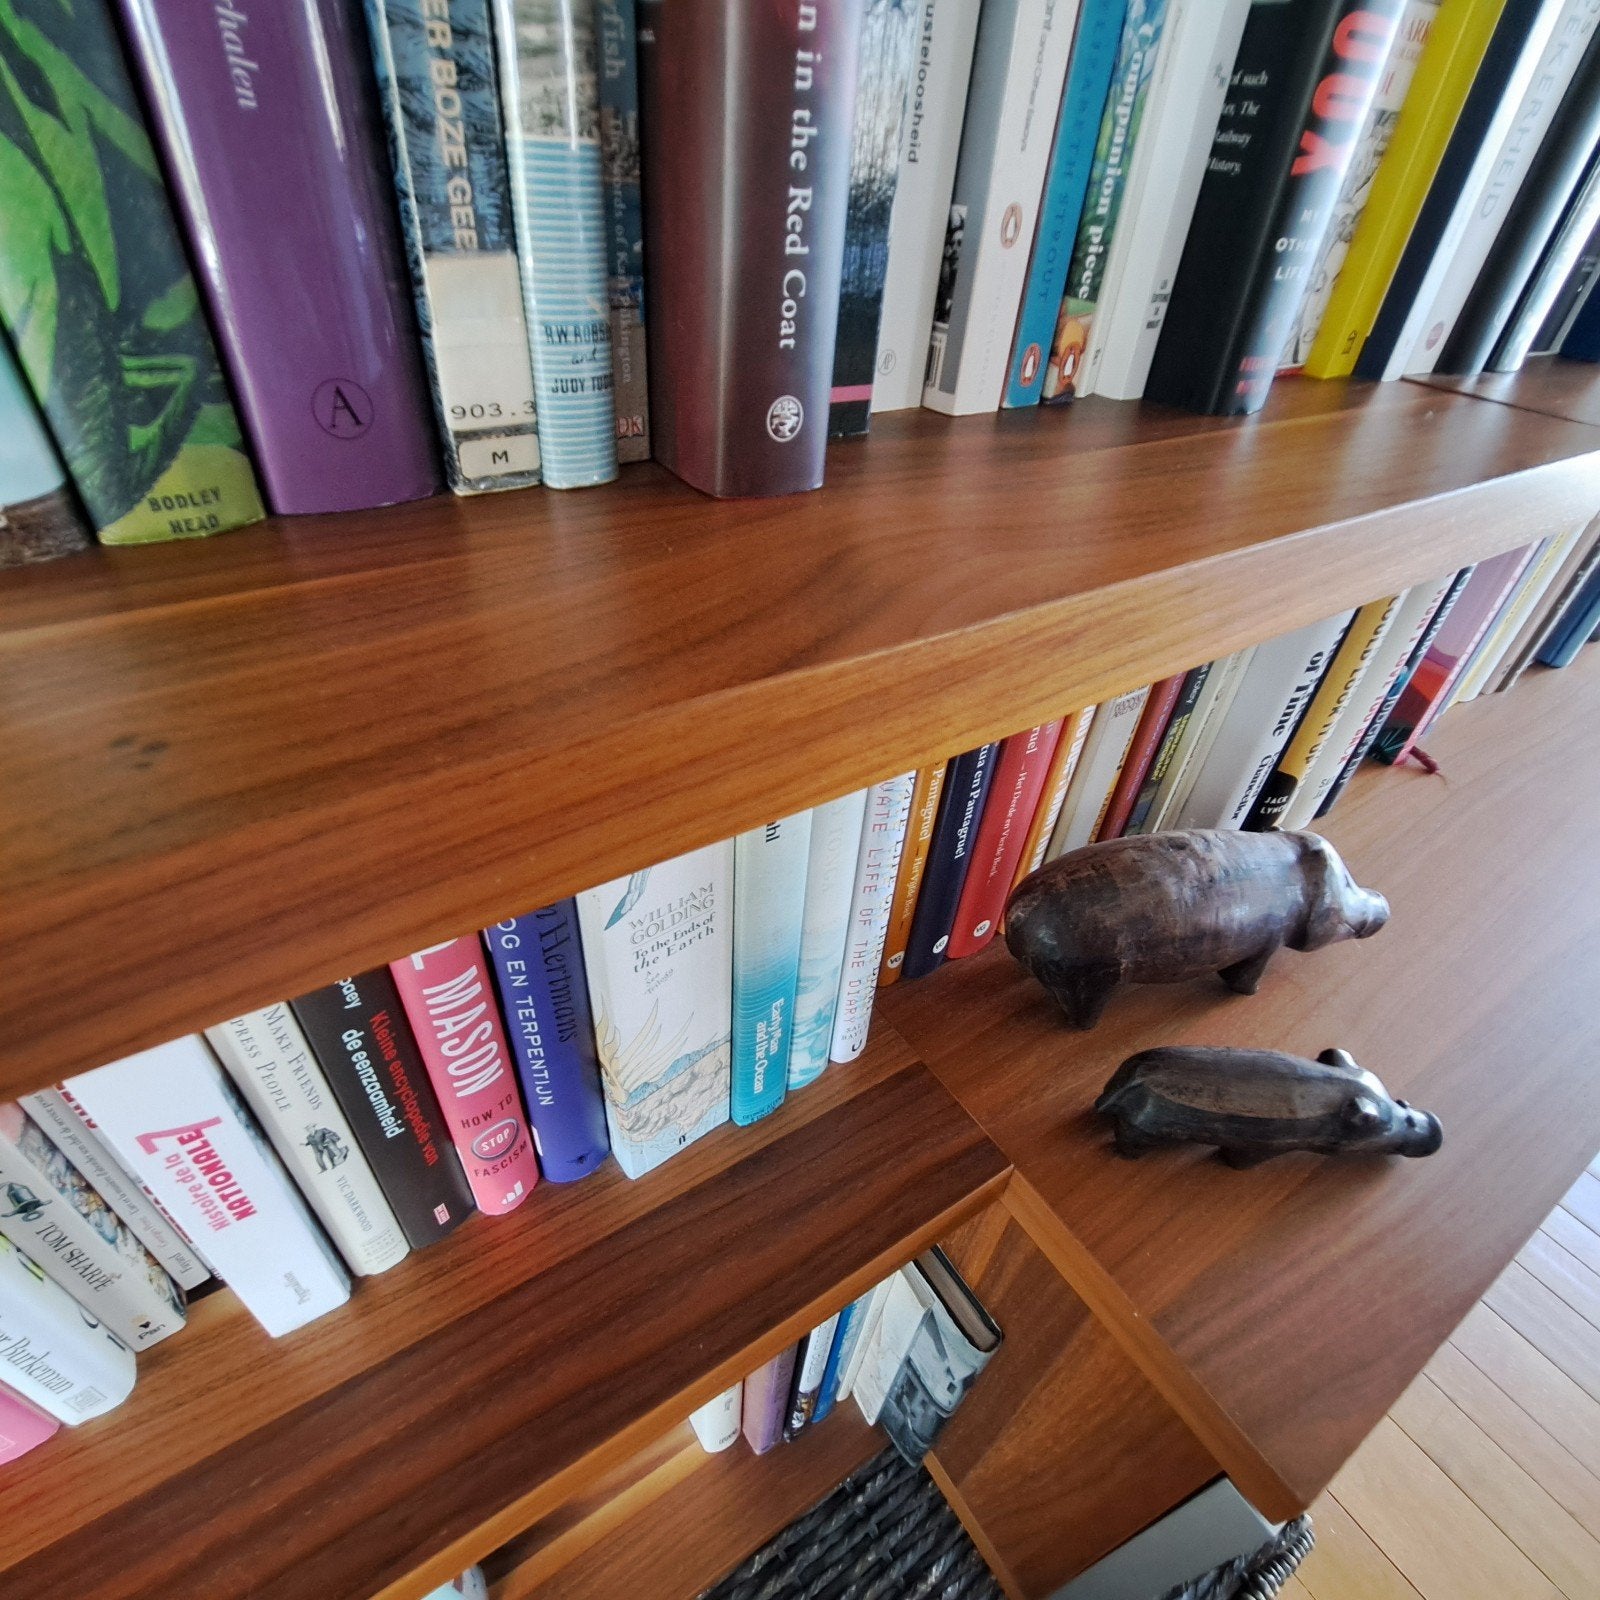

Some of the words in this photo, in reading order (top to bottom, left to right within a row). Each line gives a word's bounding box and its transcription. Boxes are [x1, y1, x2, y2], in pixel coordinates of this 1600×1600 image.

[602, 0, 626, 79] fish
[795, 50, 823, 91] in
[1242, 69, 1269, 86] such
[430, 58, 468, 167] BOZE
[789, 108, 819, 171] the
[785, 187, 813, 256] Red
[779, 269, 807, 350] Coat
[617, 417, 642, 436] DK
[491, 450, 510, 465] M
[147, 485, 220, 513] BODLEY
[168, 513, 219, 535] HEAD
[1303, 648, 1326, 677] of
[1268, 678, 1311, 740] Time
[973, 769, 984, 783] en
[1228, 752, 1274, 822] Chancellor
[1263, 795, 1289, 805] JACK
[918, 768, 946, 842] Pantagruel
[954, 784, 982, 860] Pantagruel
[1002, 818, 1011, 829] en
[1004, 789, 1023, 818] Derde
[992, 828, 1011, 857] Vierde
[862, 847, 883, 895] LIFE
[987, 856, 1001, 878] Boek
[628, 882, 715, 931] WILLIAM
[630, 894, 716, 945] GOLDING
[859, 907, 874, 927] OF
[632, 948, 649, 961] To
[650, 936, 671, 954] the
[673, 922, 701, 942] Ends
[702, 911, 717, 925] of
[633, 955, 660, 974] the
[666, 926, 716, 957] Earth
[850, 939, 869, 970] THE
[506, 959, 530, 988] EN
[538, 914, 578, 1045] Hertmans
[842, 979, 862, 1024] DIARY
[340, 1027, 366, 1051] de
[421, 963, 506, 1099] MASON
[515, 995, 555, 1107] TERPENTIJN
[256, 1059, 293, 1113] PEOPLE
[286, 1051, 323, 1112] FRIENDS
[350, 1044, 407, 1141] eenzaamheid
[368, 1008, 398, 1063] Kleine
[388, 1056, 434, 1146] encyclopedie
[422, 1139, 440, 1167] van
[753, 1059, 769, 1095] Ocean
[459, 1106, 495, 1130] HOW
[497, 1092, 515, 1112] TO
[164, 1152, 182, 1170] la
[473, 1140, 530, 1179] FASCISM
[479, 1126, 512, 1153] STOP
[175, 1165, 197, 1185] de
[177, 1128, 258, 1222] NATIONALE
[188, 1180, 231, 1232] Histoire
[335, 1174, 350, 1194] VIC
[344, 1190, 374, 1233] DARKWOOD
[35, 1222, 70, 1254] TOM
[61, 1248, 115, 1293] SHARPE
[6, 1337, 75, 1395] Burkeman
